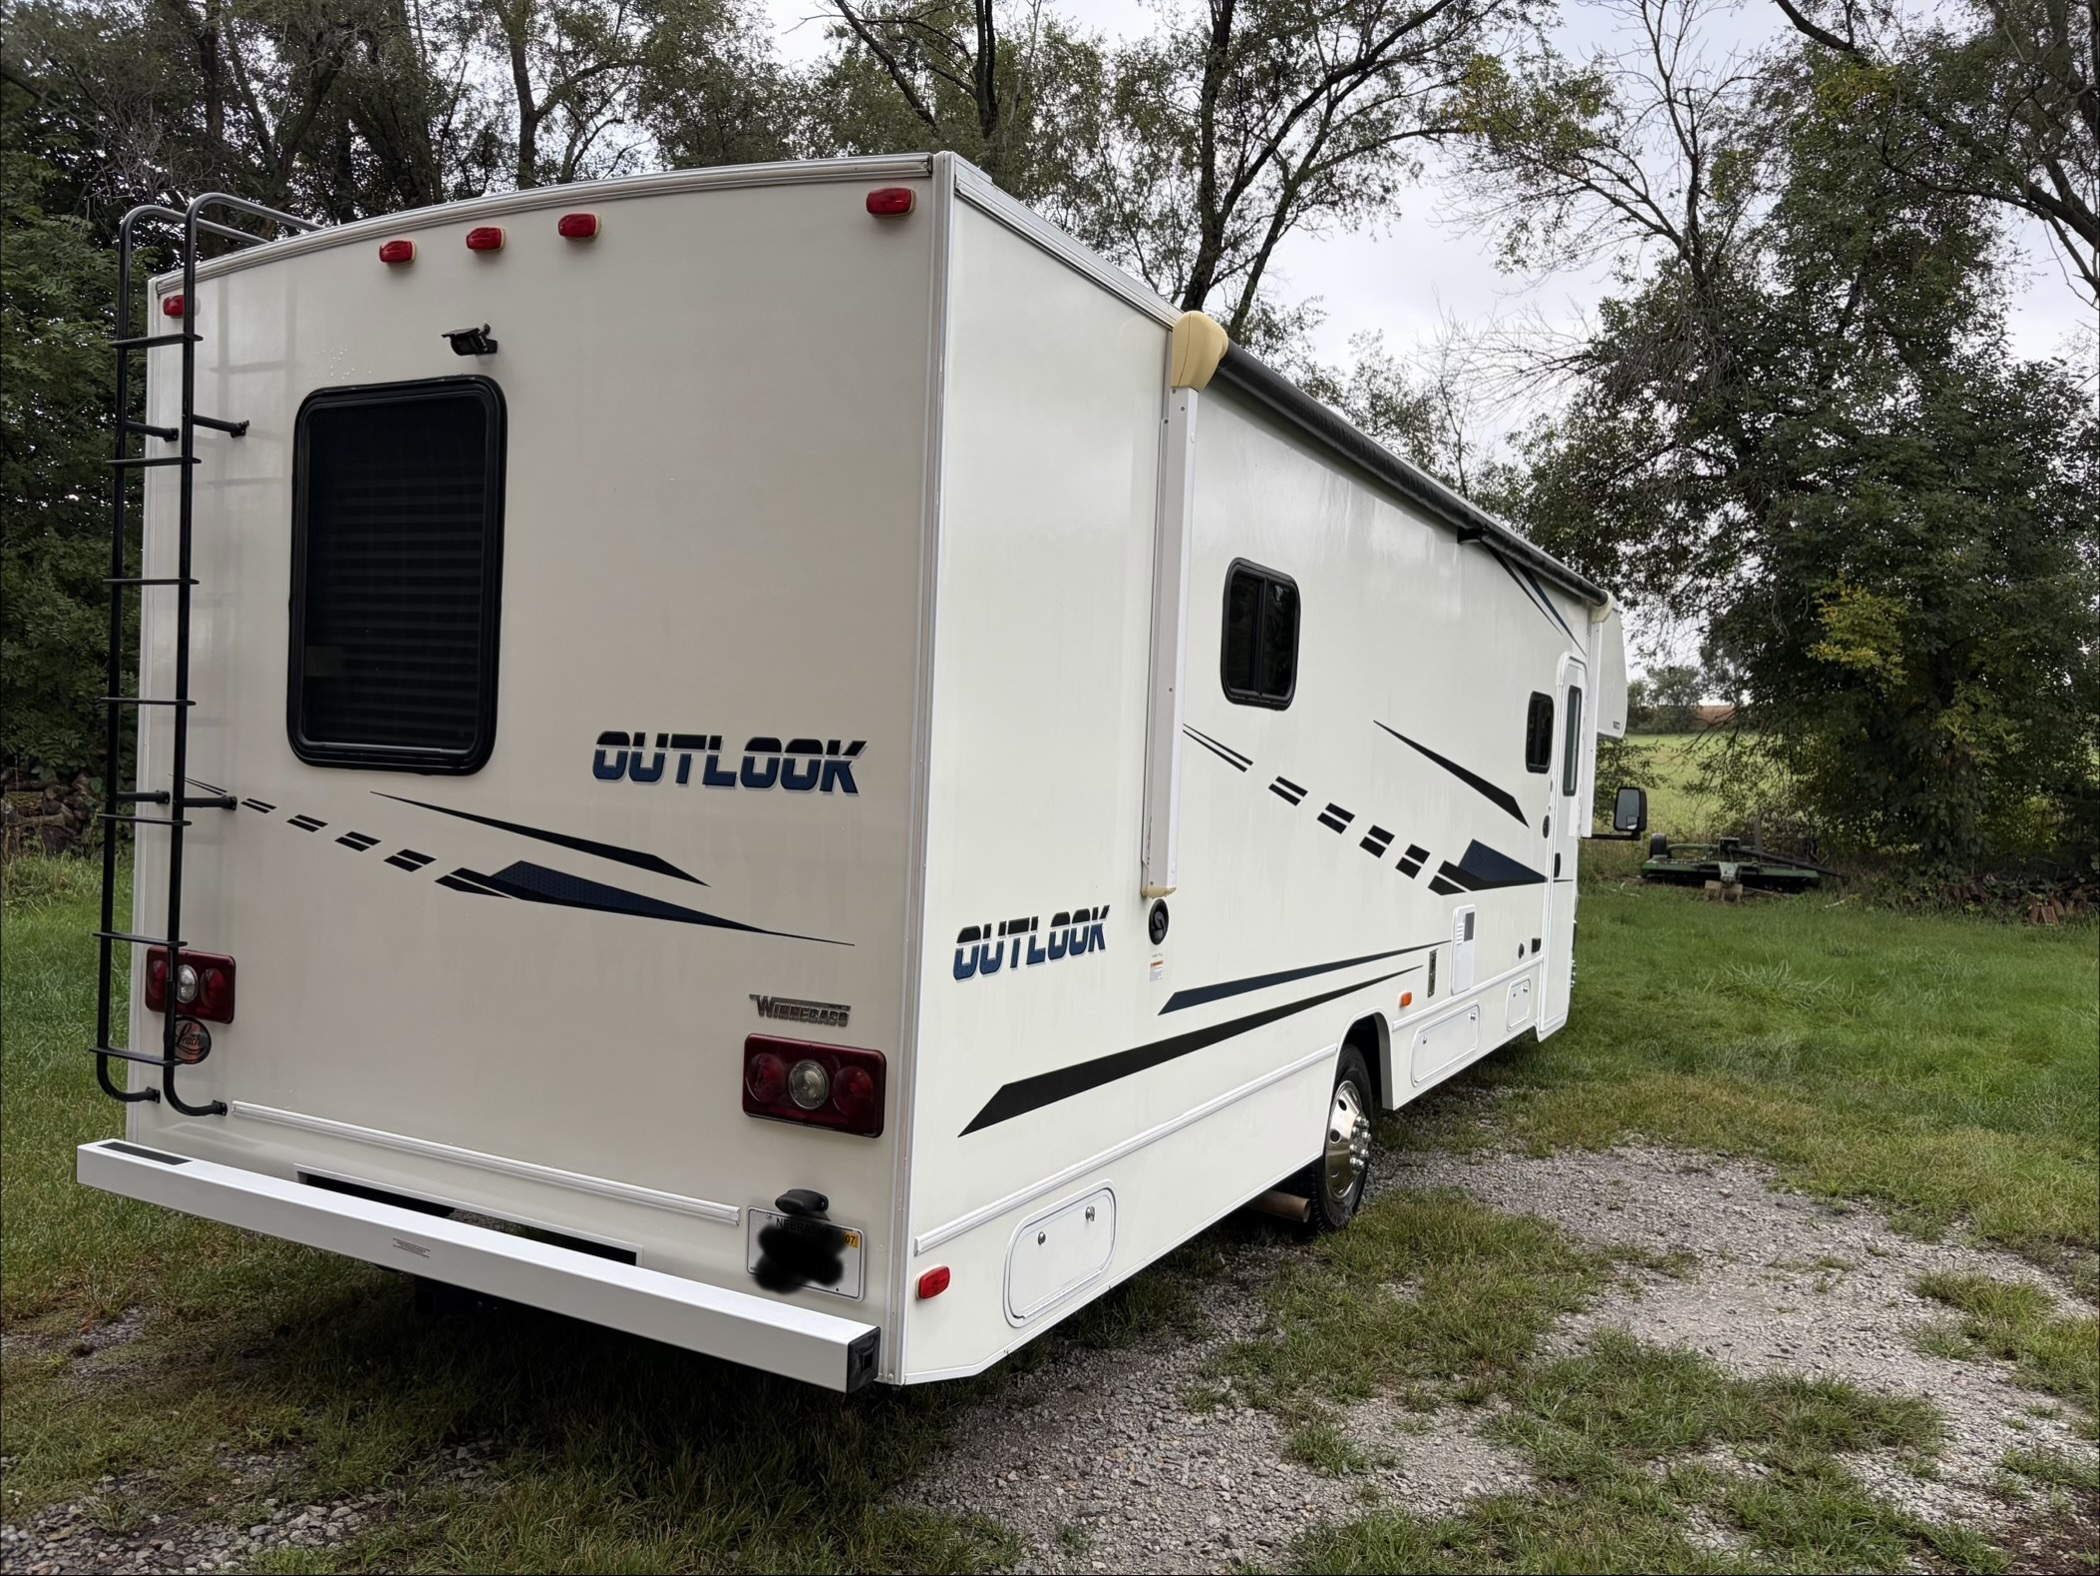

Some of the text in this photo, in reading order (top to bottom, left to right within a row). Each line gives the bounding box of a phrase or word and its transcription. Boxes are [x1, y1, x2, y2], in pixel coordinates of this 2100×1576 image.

[592, 730, 867, 794] OUTLOOK
[952, 904, 1111, 981] OUTLOOK
[844, 1235, 856, 1245] 07
